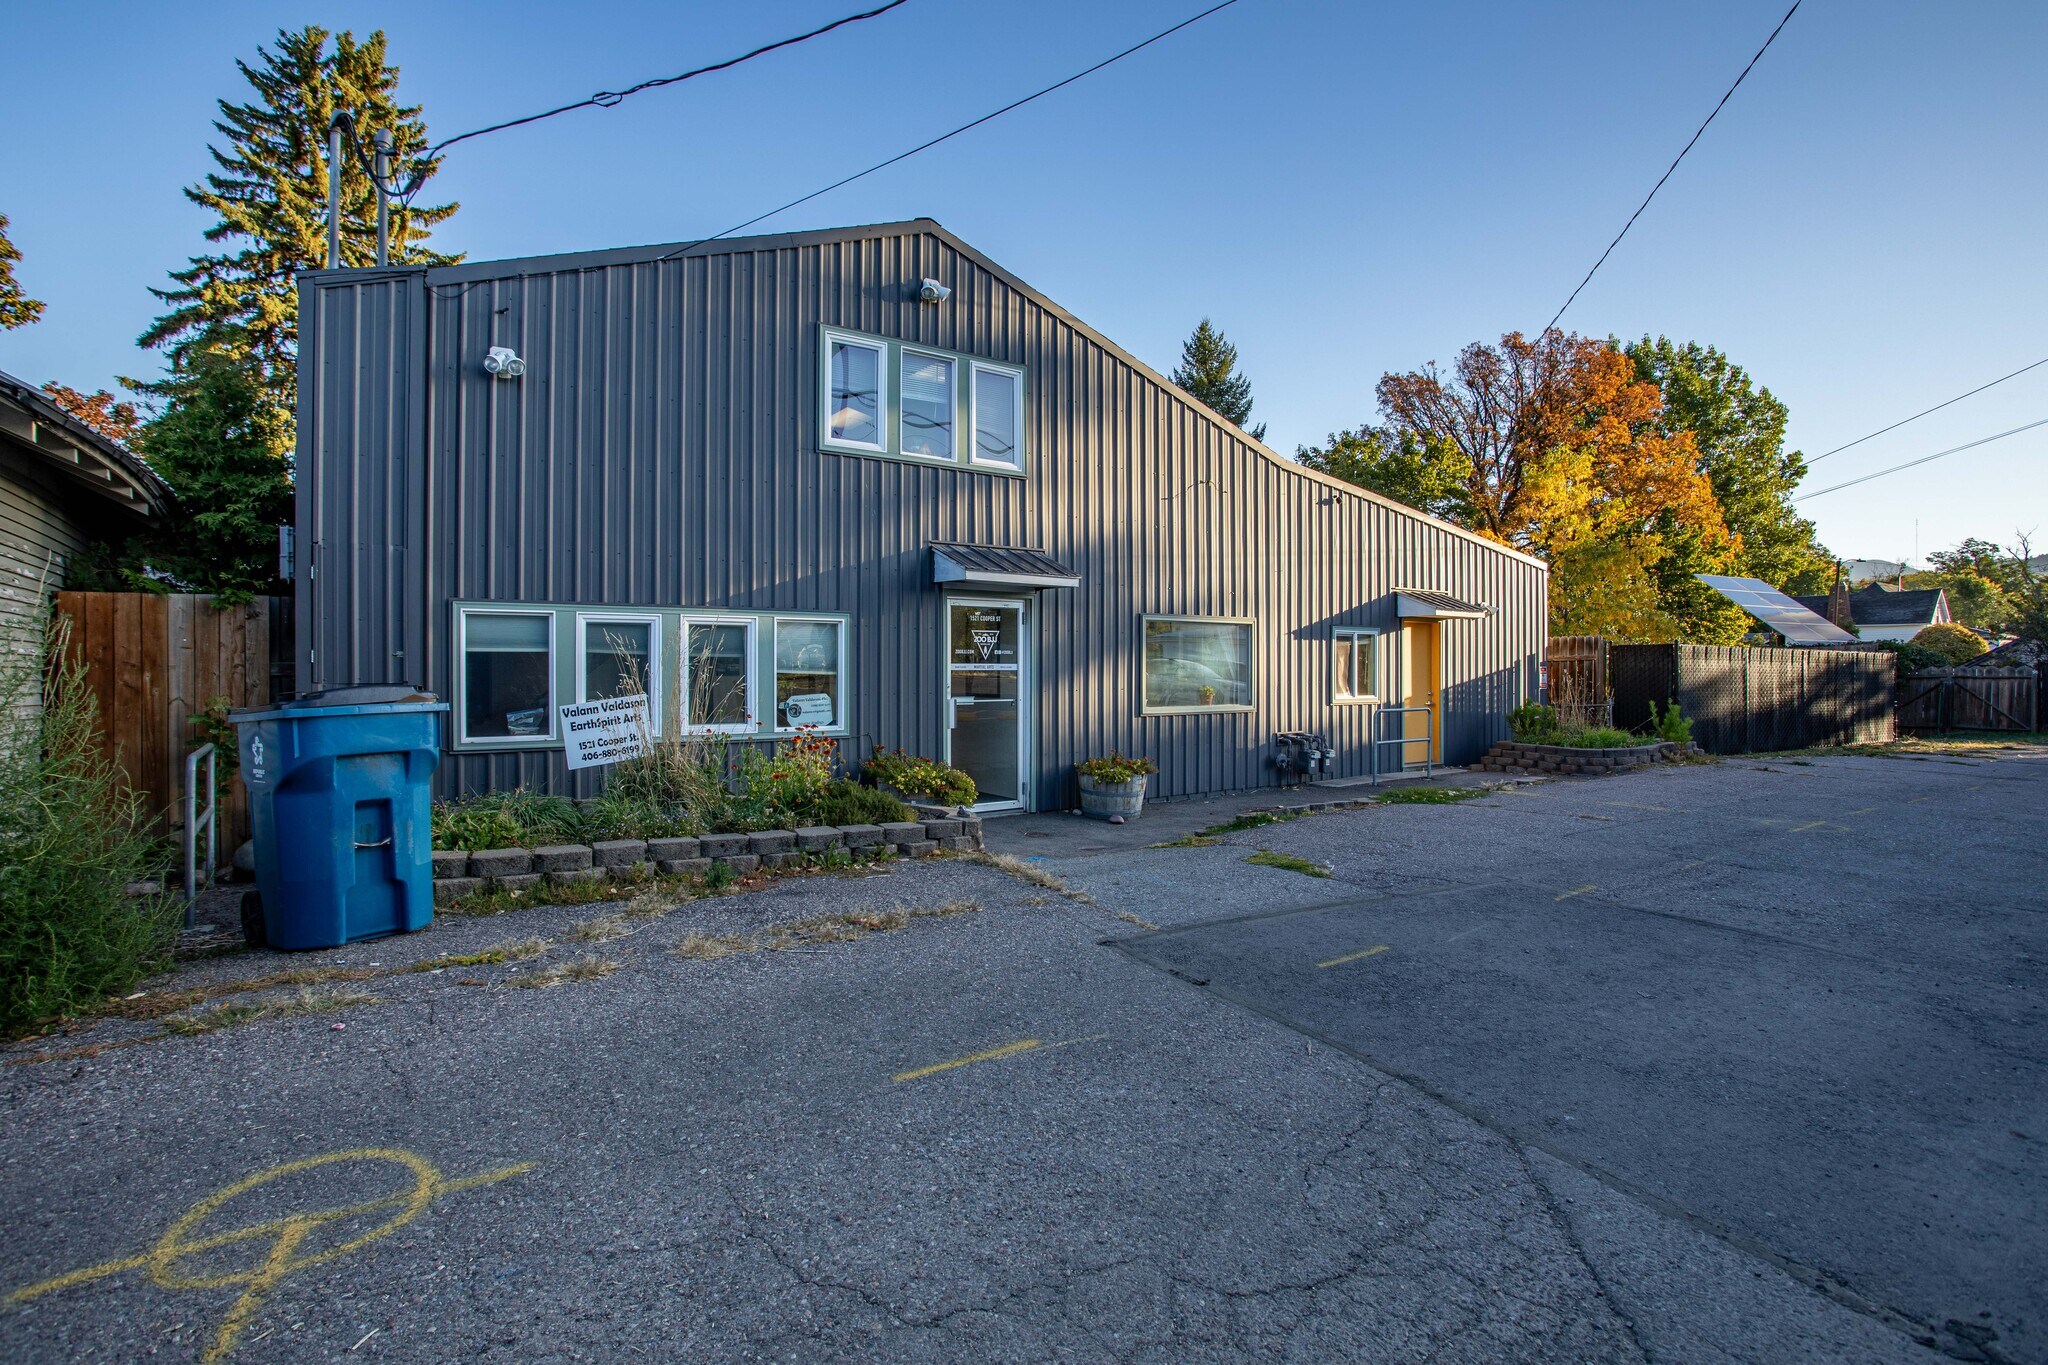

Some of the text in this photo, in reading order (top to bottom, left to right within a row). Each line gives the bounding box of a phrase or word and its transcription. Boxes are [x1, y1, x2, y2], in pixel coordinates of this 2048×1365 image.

[562, 700, 646, 718] Valann Valdason
[570, 715, 621, 731] EarthSpirit
[579, 733, 639, 750] 1521 Cooper St.
[581, 744, 640, 761] 406-880-6199
